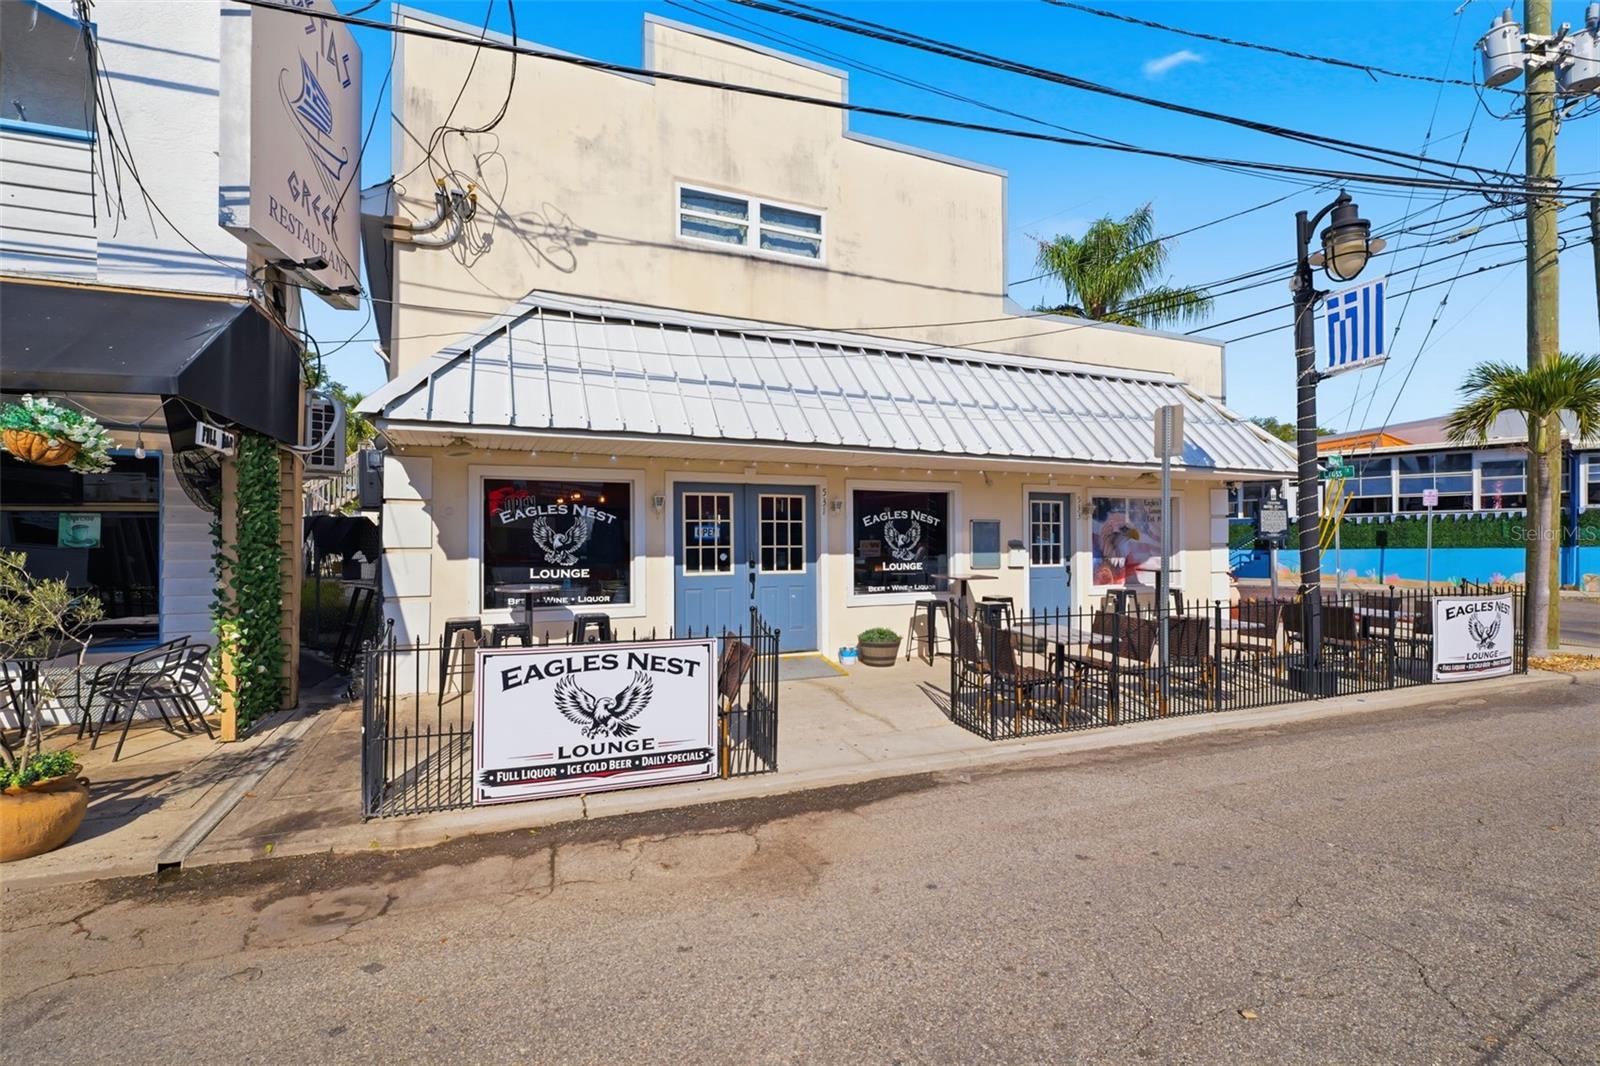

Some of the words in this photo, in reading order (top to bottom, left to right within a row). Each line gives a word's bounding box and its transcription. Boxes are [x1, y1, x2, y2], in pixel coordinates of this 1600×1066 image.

[287, 170, 339, 242] GREEK
[269, 194, 350, 280] RESTAURANT
[202, 425, 217, 447] FULL
[500, 504, 568, 525] EAGLES
[573, 503, 617, 525] NEST
[862, 510, 908, 527] EAGLES
[910, 510, 941, 527] NEST
[529, 567, 591, 580] LOUNGE
[882, 561, 923, 571] LOUNGE
[868, 585, 886, 593] BEER
[890, 584, 909, 592] WINE
[914, 583, 936, 591] LIQUOR
[543, 596, 569, 604] WINE
[577, 595, 611, 603] LIQUOR
[1445, 601, 1494, 621] EAGLES
[1494, 600, 1511, 616] NEST
[1466, 649, 1499, 661] LOUNGE
[501, 653, 619, 692] EAGLES
[626, 652, 701, 678] NEST
[557, 738, 655, 760] LOUNGE
[496, 770, 519, 783] FULL
[521, 766, 557, 781] LIQUOR
[566, 764, 582, 776] ICE
[583, 761, 608, 774] COLD
[609, 758, 632, 771] BEER
[641, 755, 666, 767] DAILY
[667, 750, 704, 764] SPECIALS
